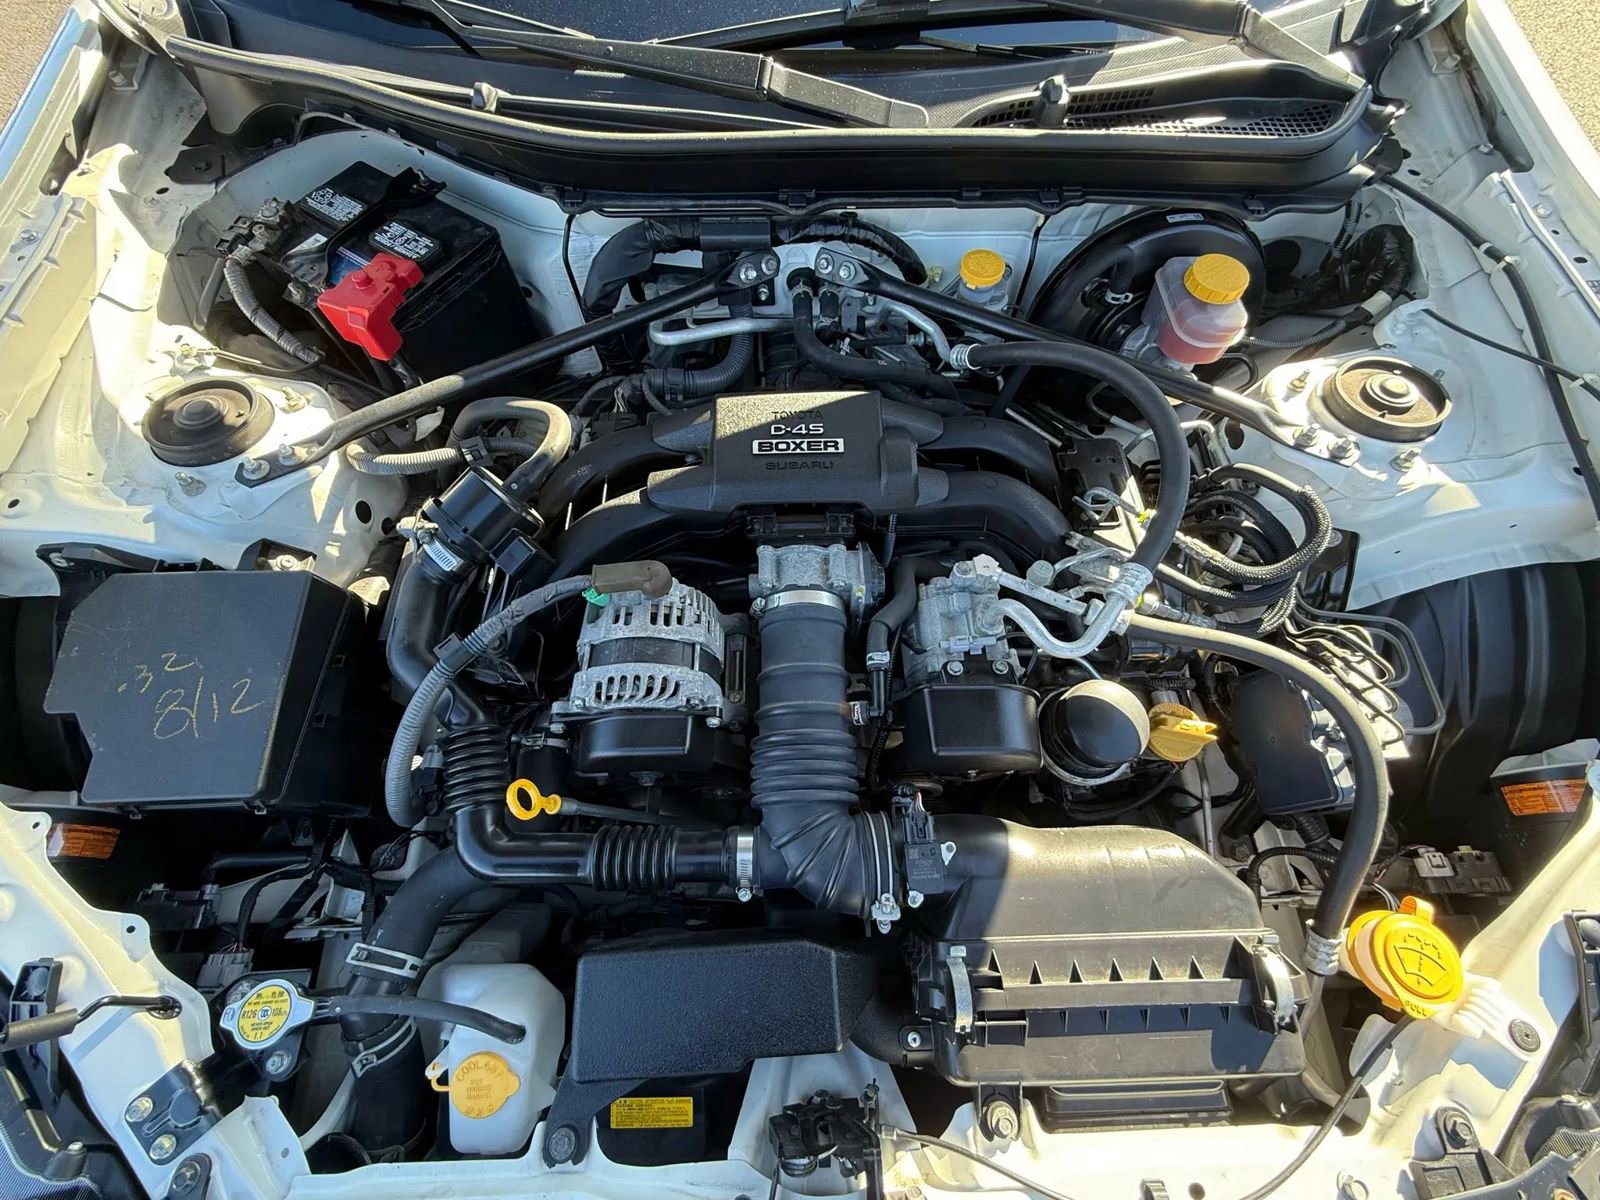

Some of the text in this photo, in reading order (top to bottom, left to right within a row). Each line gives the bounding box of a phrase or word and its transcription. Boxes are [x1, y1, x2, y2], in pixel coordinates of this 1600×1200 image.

[771, 410, 824, 420] TOYOTA
[770, 423, 824, 435] D-4S
[757, 440, 840, 452] BOXER
[765, 461, 834, 470] SUBARU
[153, 676, 264, 739] 8/12
[1405, 1000, 1427, 1017] PULL
